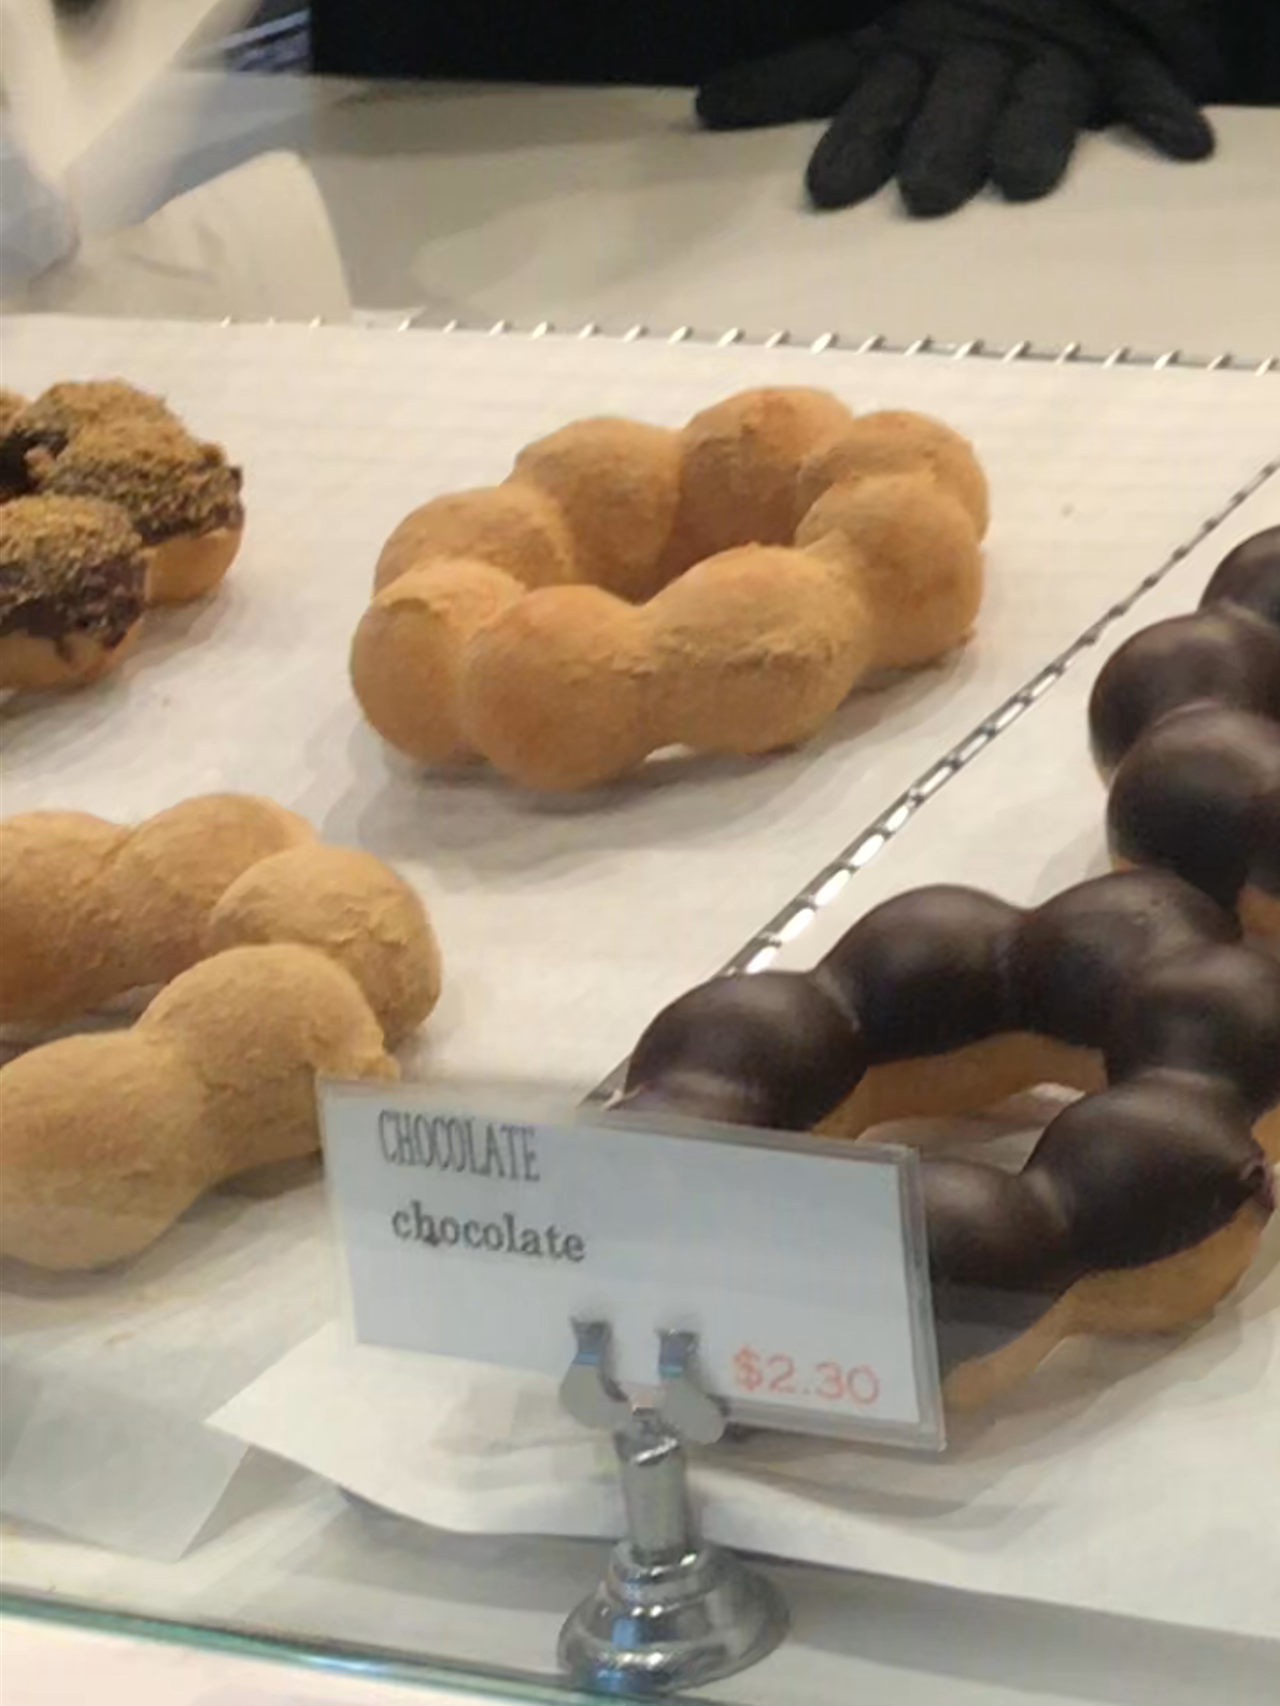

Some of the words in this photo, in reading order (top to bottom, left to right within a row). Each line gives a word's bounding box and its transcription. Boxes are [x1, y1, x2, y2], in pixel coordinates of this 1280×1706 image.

[378, 1110, 540, 1183] CHOCOLATE
[392, 1200, 586, 1262] chocolate
[733, 1345, 879, 1405] $2.30
